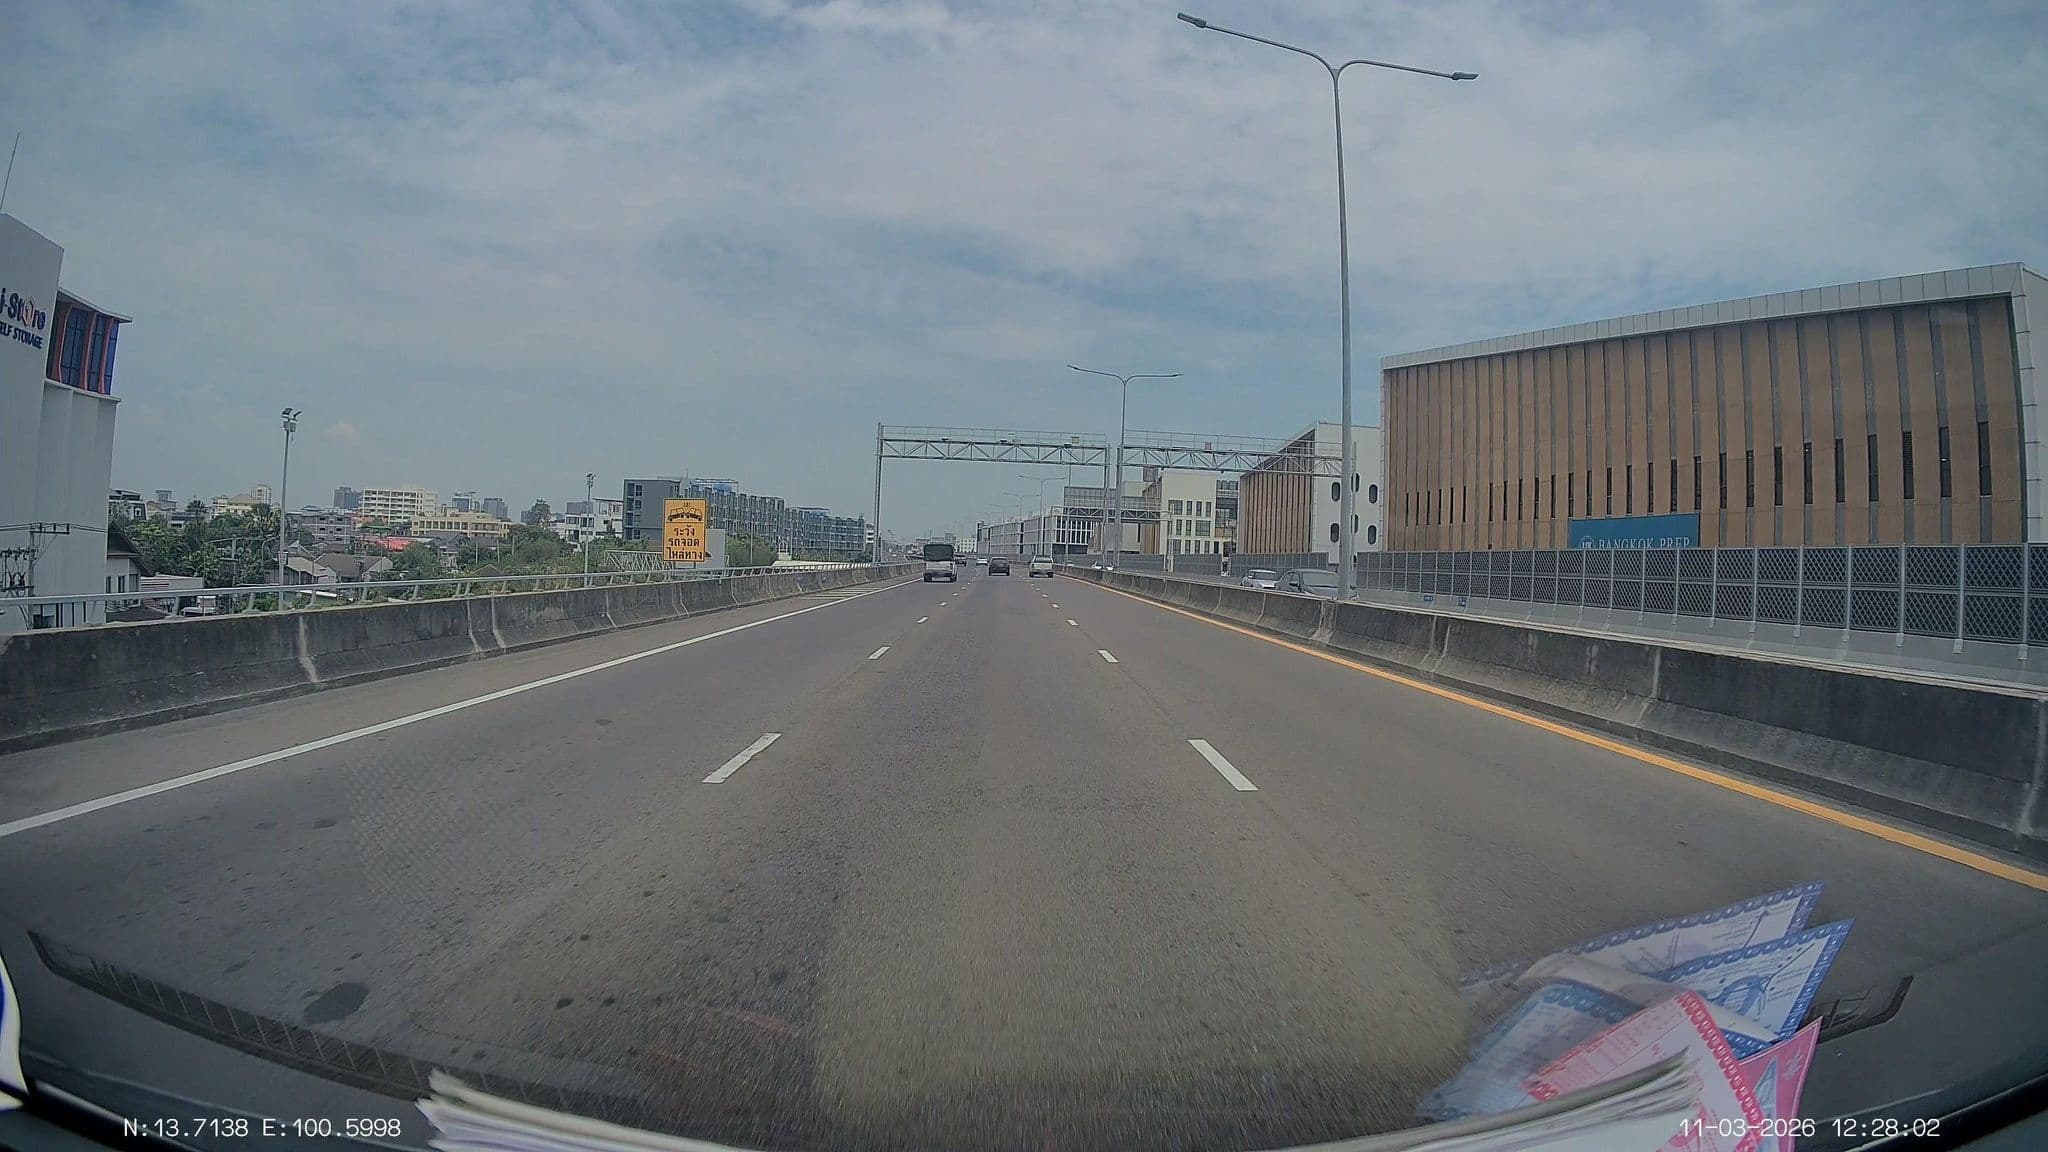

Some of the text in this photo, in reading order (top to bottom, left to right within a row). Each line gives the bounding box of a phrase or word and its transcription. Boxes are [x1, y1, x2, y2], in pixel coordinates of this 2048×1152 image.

[0, 321, 43, 349] ELF STORAGE
[673, 524, 695, 536] ระวัง
[668, 538, 700, 547] รถจอด
[1599, 538, 1654, 549] BANGKOK
[1660, 537, 1690, 548] PREP
[666, 547, 703, 560] ไหล่ทาง
